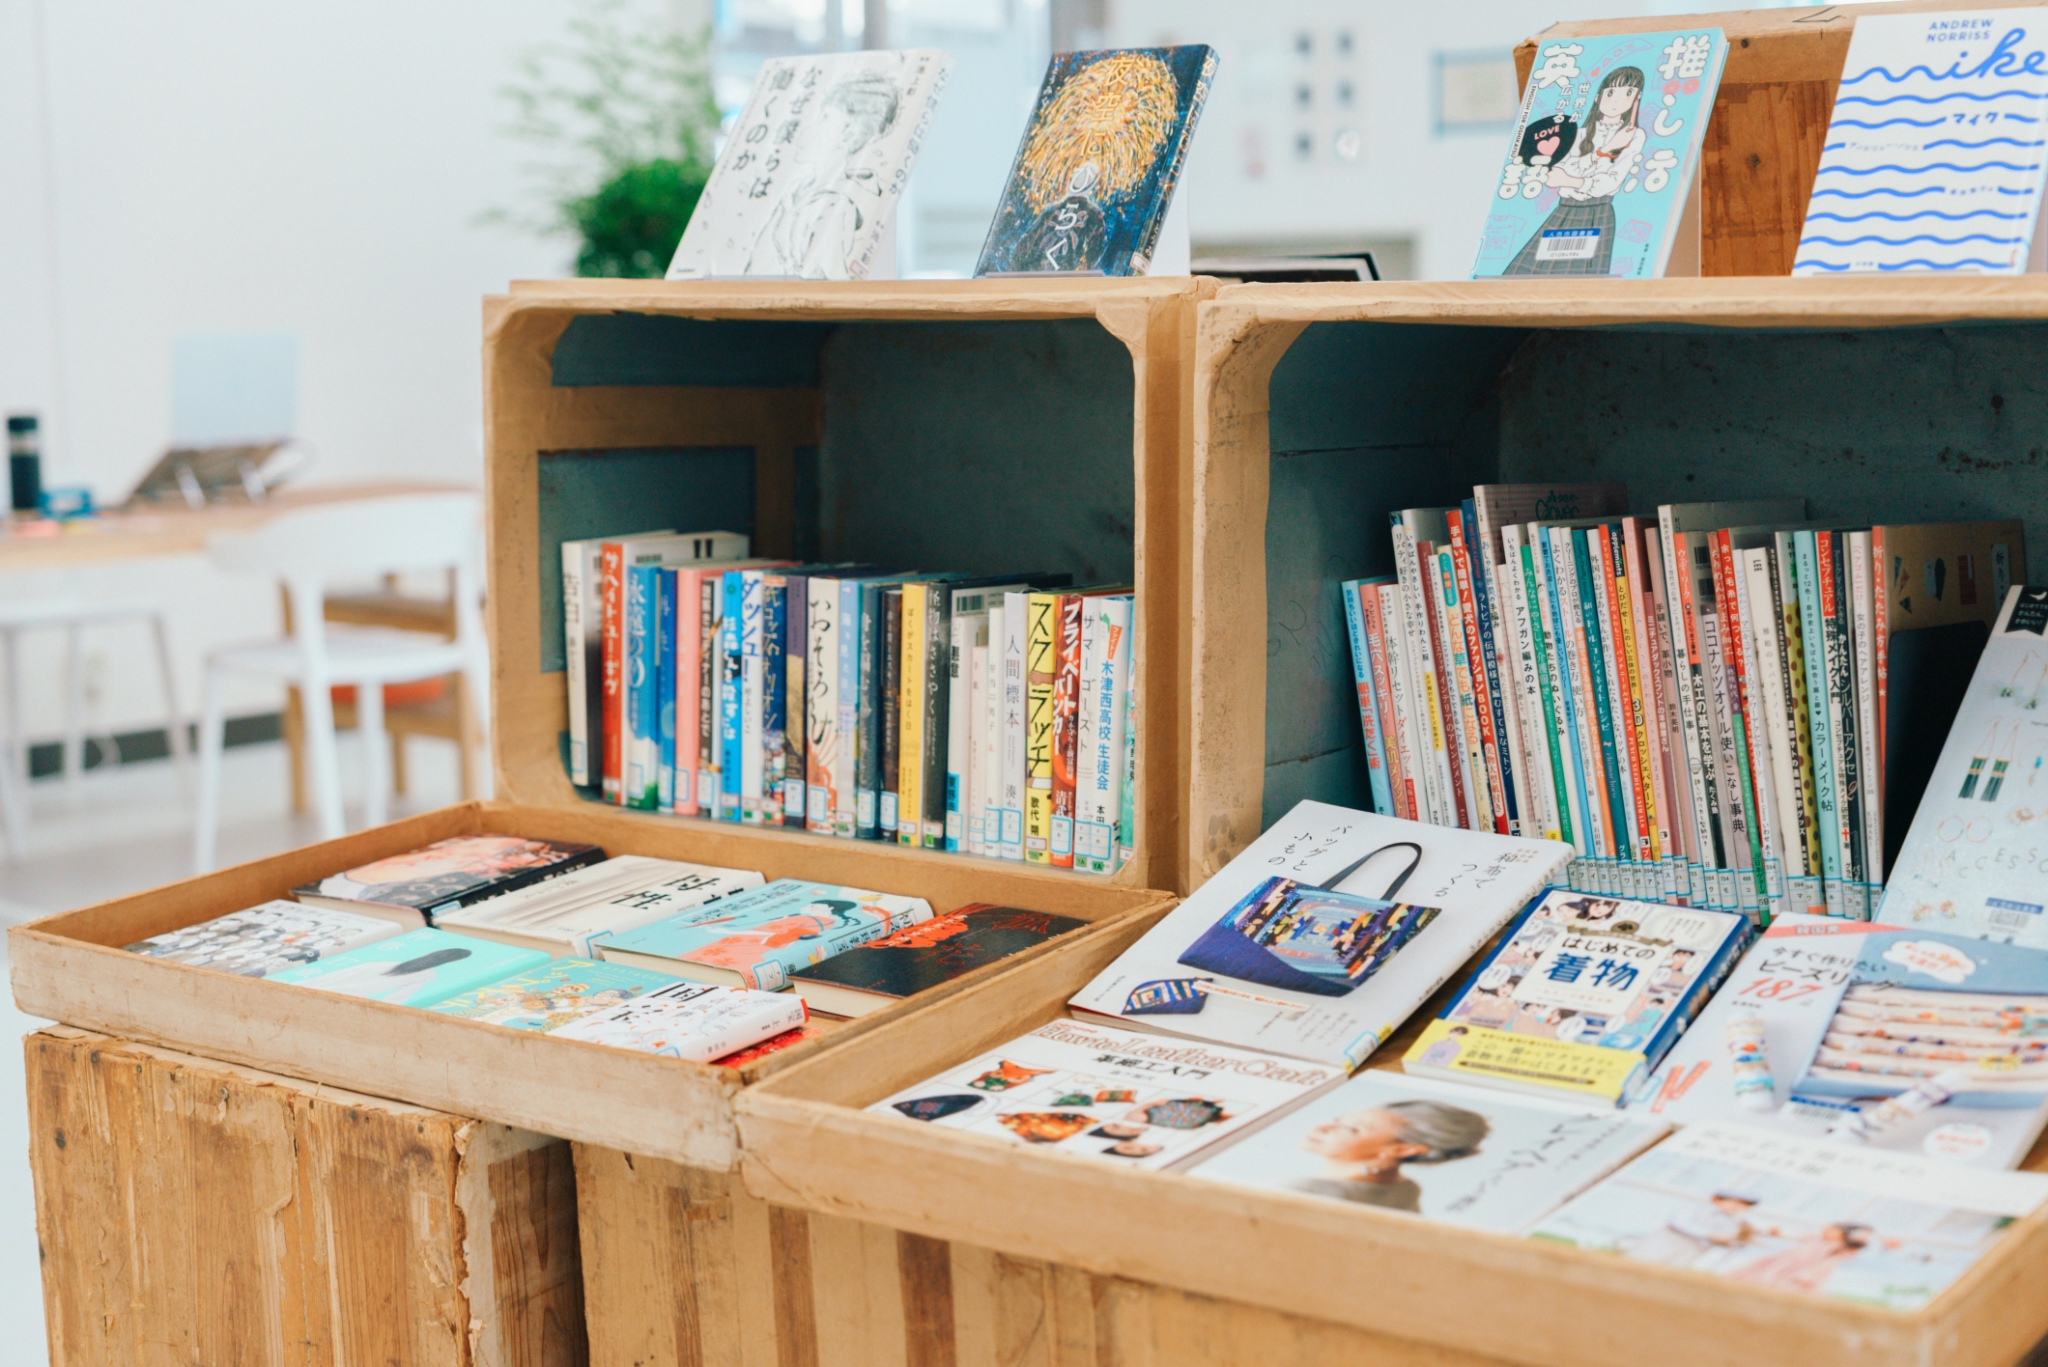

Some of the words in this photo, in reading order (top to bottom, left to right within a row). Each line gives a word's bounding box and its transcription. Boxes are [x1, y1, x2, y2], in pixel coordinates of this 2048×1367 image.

[1926, 31, 1990, 43] NORRISS
[1929, 19, 1994, 30] ANDREW
[1525, 85, 1537, 112] ENGLISH
[1553, 84, 1573, 123] 広がる
[1568, 83, 1591, 123] 世界が
[1953, 112, 1998, 126] マイク
[1534, 125, 1560, 140] LOVE
[1045, 57, 1135, 270] 夜空にひらく
[1611, 531, 1622, 576] applemints
[1753, 559, 1762, 572] LEE
[1820, 539, 1835, 613] コンセプチュアル
[1507, 538, 1521, 600] いちばんよくわかる
[1516, 606, 1536, 695] アフガン編みの本
[1720, 544, 1744, 667] 余った毛糸で何つくる?
[1062, 601, 1081, 716] プライベート
[1368, 632, 1389, 727] 毛穴スッキリ!
[1857, 614, 1869, 703] 女の子のヘアアレンジ
[1006, 635, 1020, 728] 人間標本
[1029, 602, 1052, 777] スクラッチ
[1080, 615, 1096, 753] サマーゴースト
[1544, 630, 1565, 736] 動物たちのぬいぐるみ
[1053, 678, 1065, 756] バンカー
[1097, 660, 1114, 791] 木津西高校生徒会
[1632, 698, 1645, 727] 3D
[1693, 674, 1715, 780] 木工の基本を学ぶ
[1705, 620, 1745, 833] ココナッツオイル使いこなし事典
[1840, 679, 1856, 775] シルバーアクセ
[1637, 730, 1654, 810] クロッシェパターン
[1815, 720, 1833, 812] カラーメイク帖
[1268, 832, 1313, 865] 小もの
[1293, 826, 1352, 871] バッグと
[1475, 852, 1517, 889] 和布で
[1435, 863, 1477, 897] つくる
[1562, 936, 1656, 960] はじめての
[1773, 946, 1888, 973] 今すぐ作りたい
[1544, 952, 1640, 992] 着物
[1739, 976, 1823, 1001] 187
[1759, 960, 1902, 992] ビーズリング
